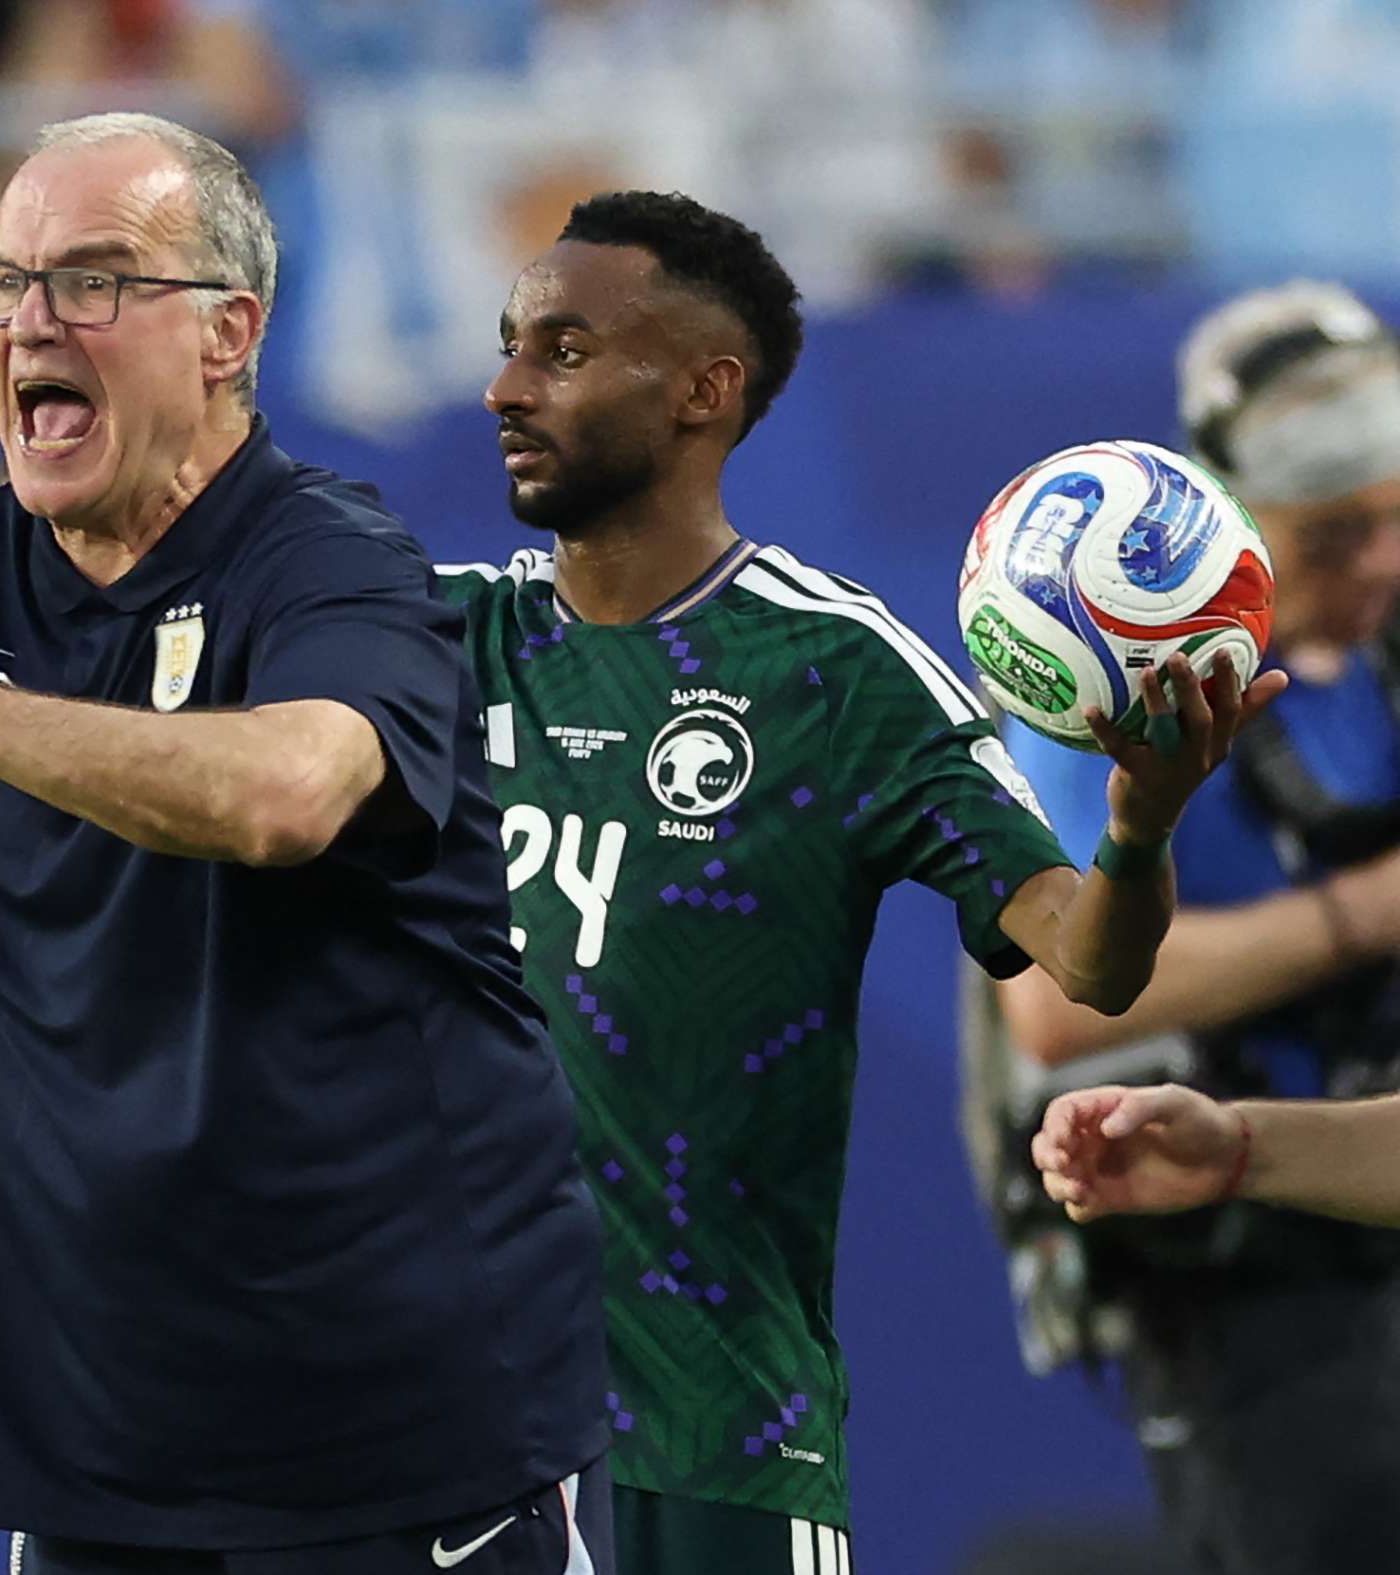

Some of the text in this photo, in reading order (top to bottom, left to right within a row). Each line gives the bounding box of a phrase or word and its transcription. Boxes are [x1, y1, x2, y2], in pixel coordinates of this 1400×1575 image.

[980, 609, 1058, 681] TRIONDA
[670, 688, 752, 715] السعودية
[699, 774, 729, 787] SAFF
[658, 819, 715, 842] SAUDI
